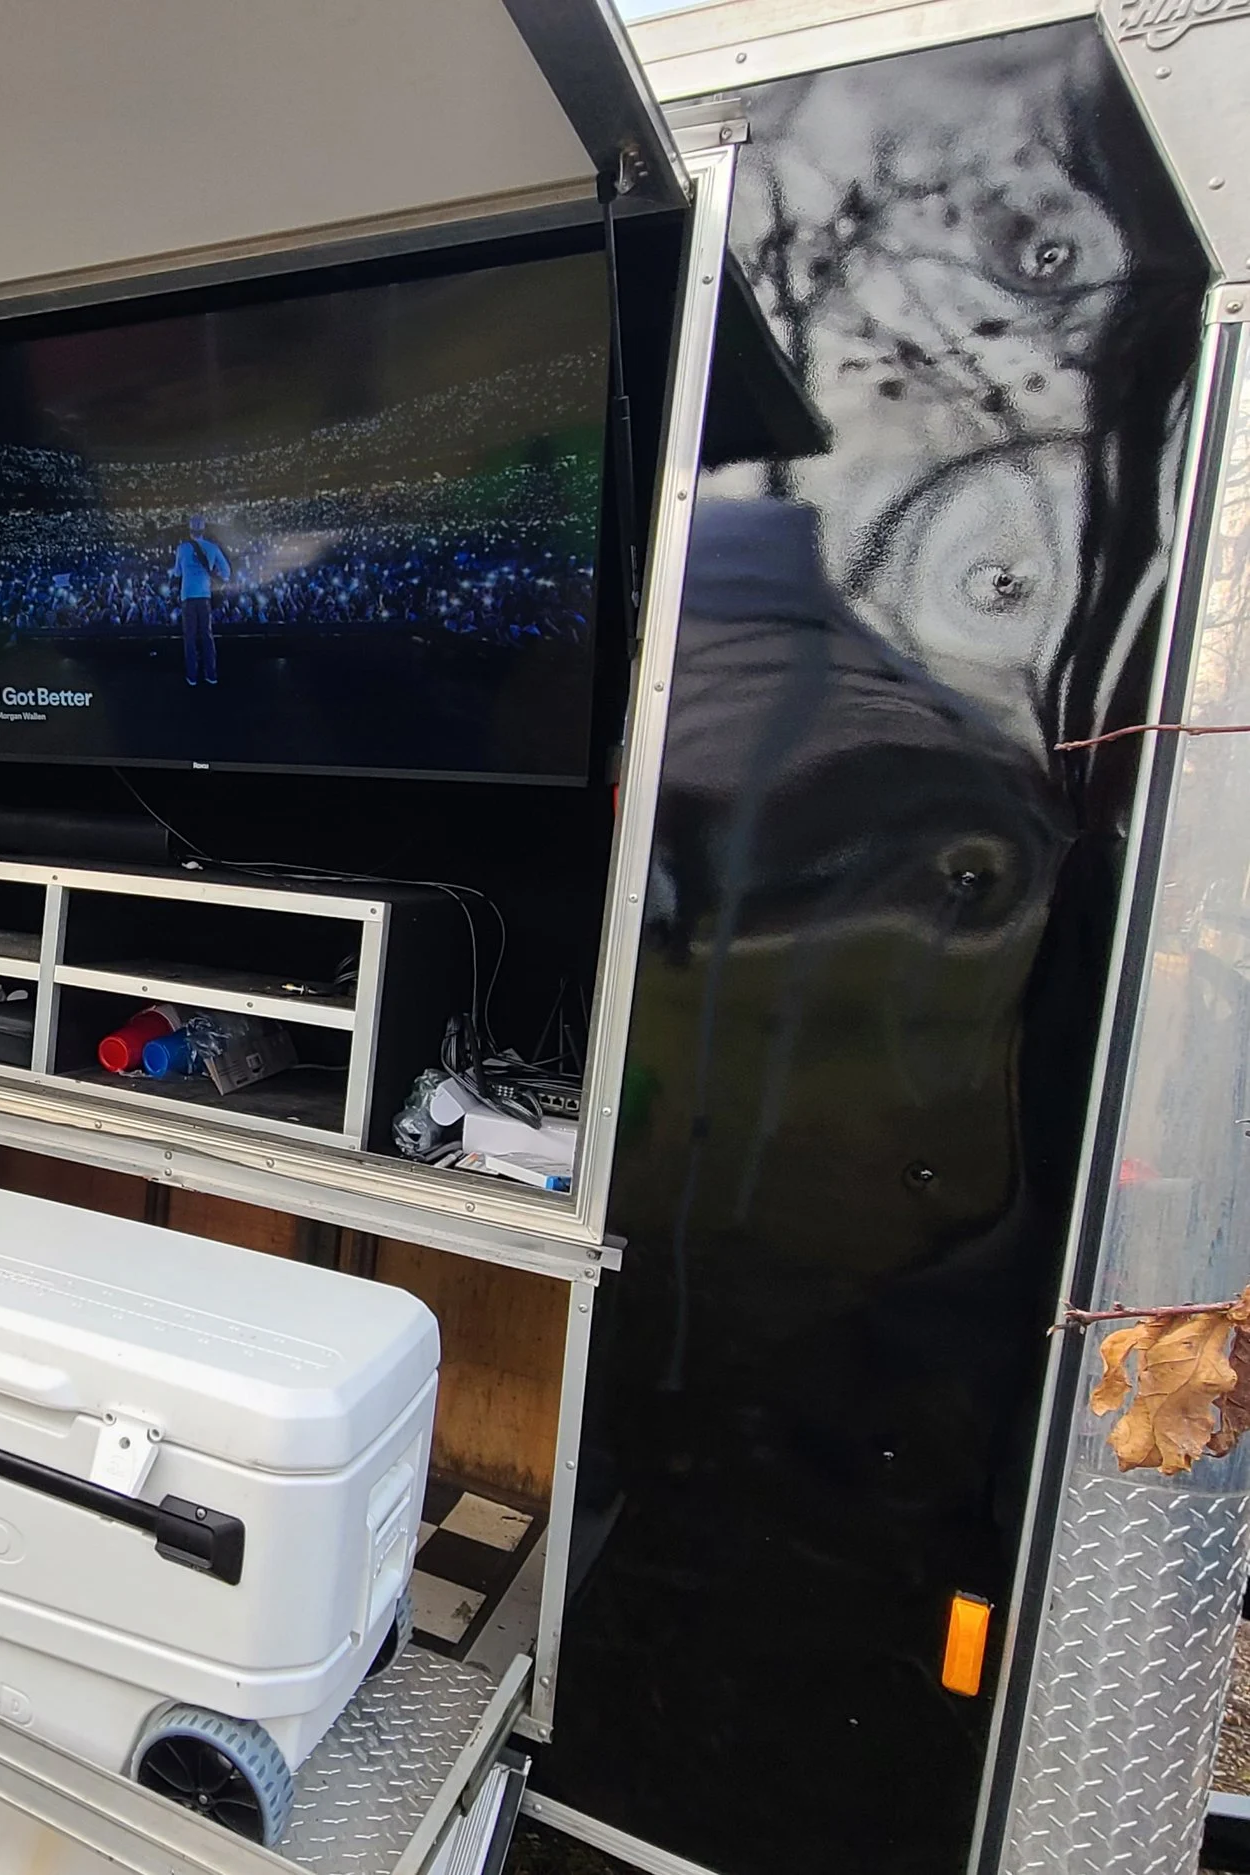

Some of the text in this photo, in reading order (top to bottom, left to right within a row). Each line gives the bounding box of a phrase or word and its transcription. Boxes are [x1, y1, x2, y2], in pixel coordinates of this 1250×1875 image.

[2, 687, 36, 706] Got
[37, 687, 93, 706] Better
[22, 712, 47, 721] Wallen
